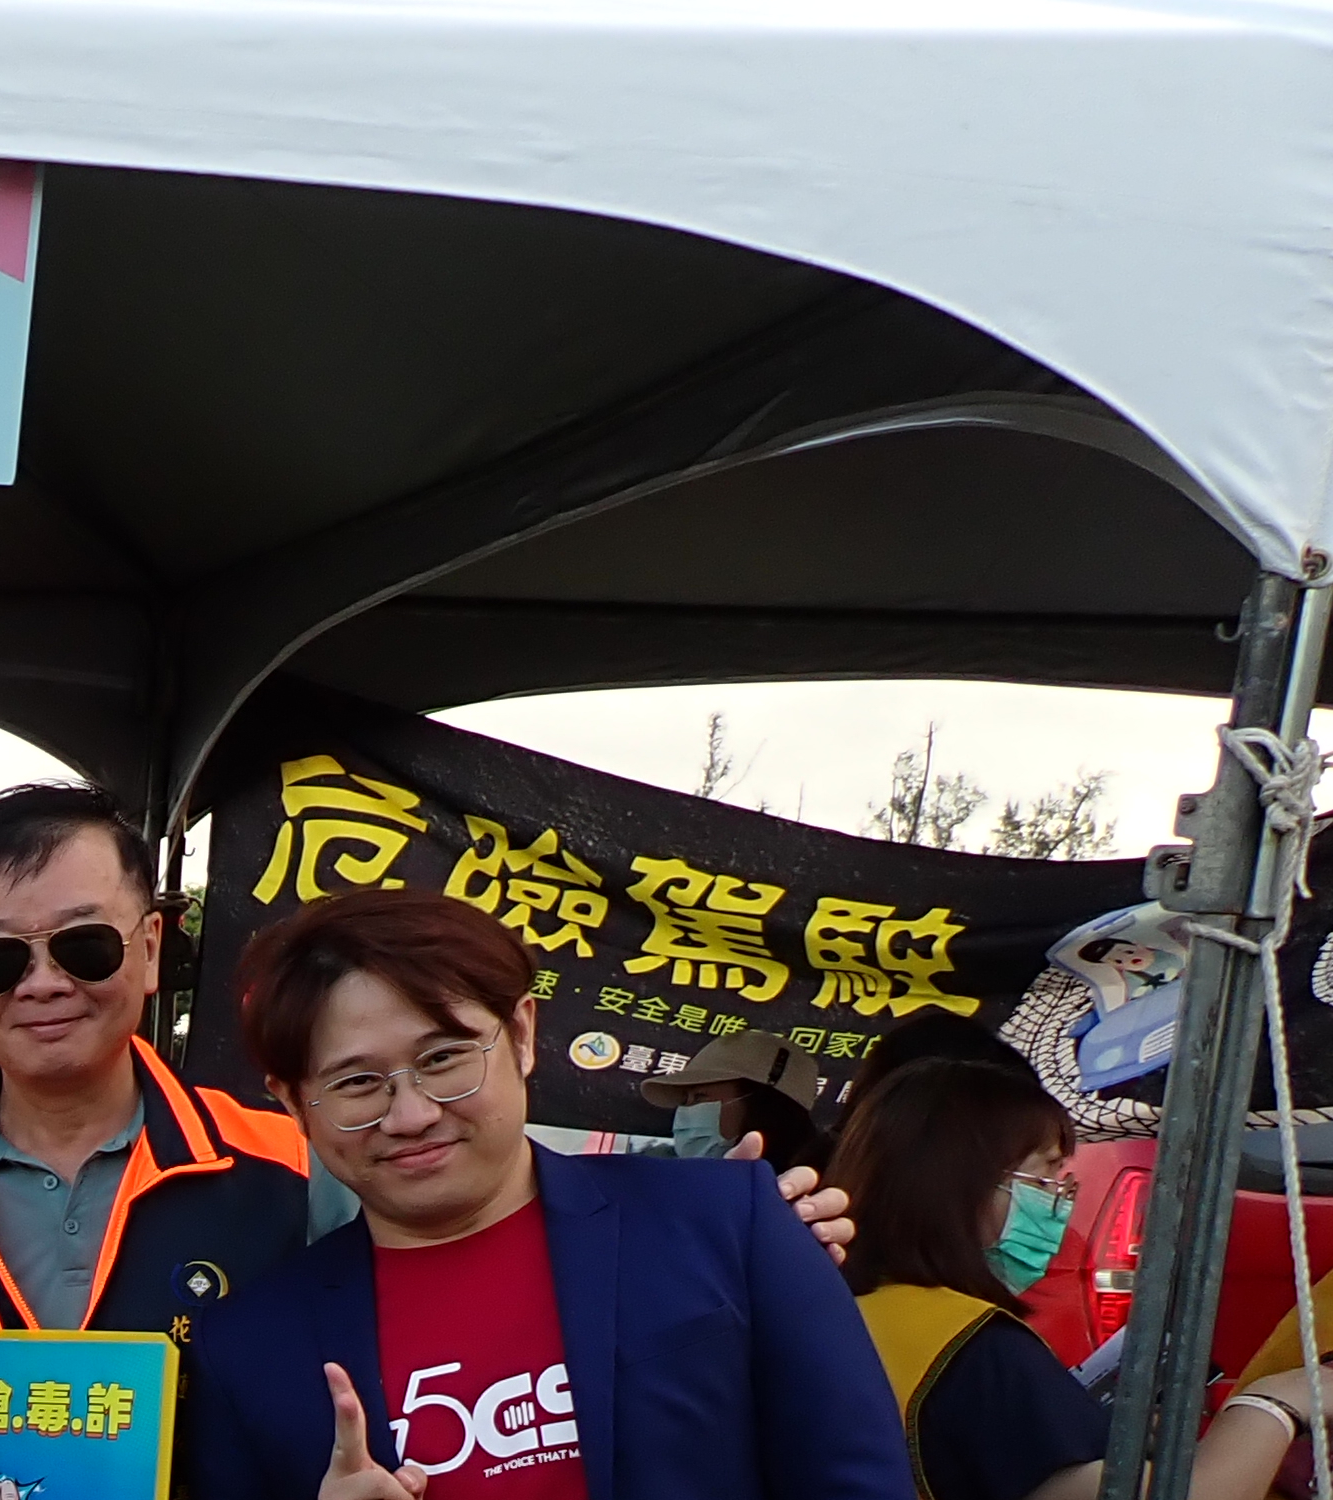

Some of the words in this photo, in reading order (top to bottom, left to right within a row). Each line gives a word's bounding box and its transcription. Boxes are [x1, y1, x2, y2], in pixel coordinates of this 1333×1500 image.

[251, 754, 982, 1021] 危險駕駛
[483, 1464, 503, 1479] THE
[503, 1454, 536, 1473] VOICE
[535, 1449, 566, 1465] THAT
